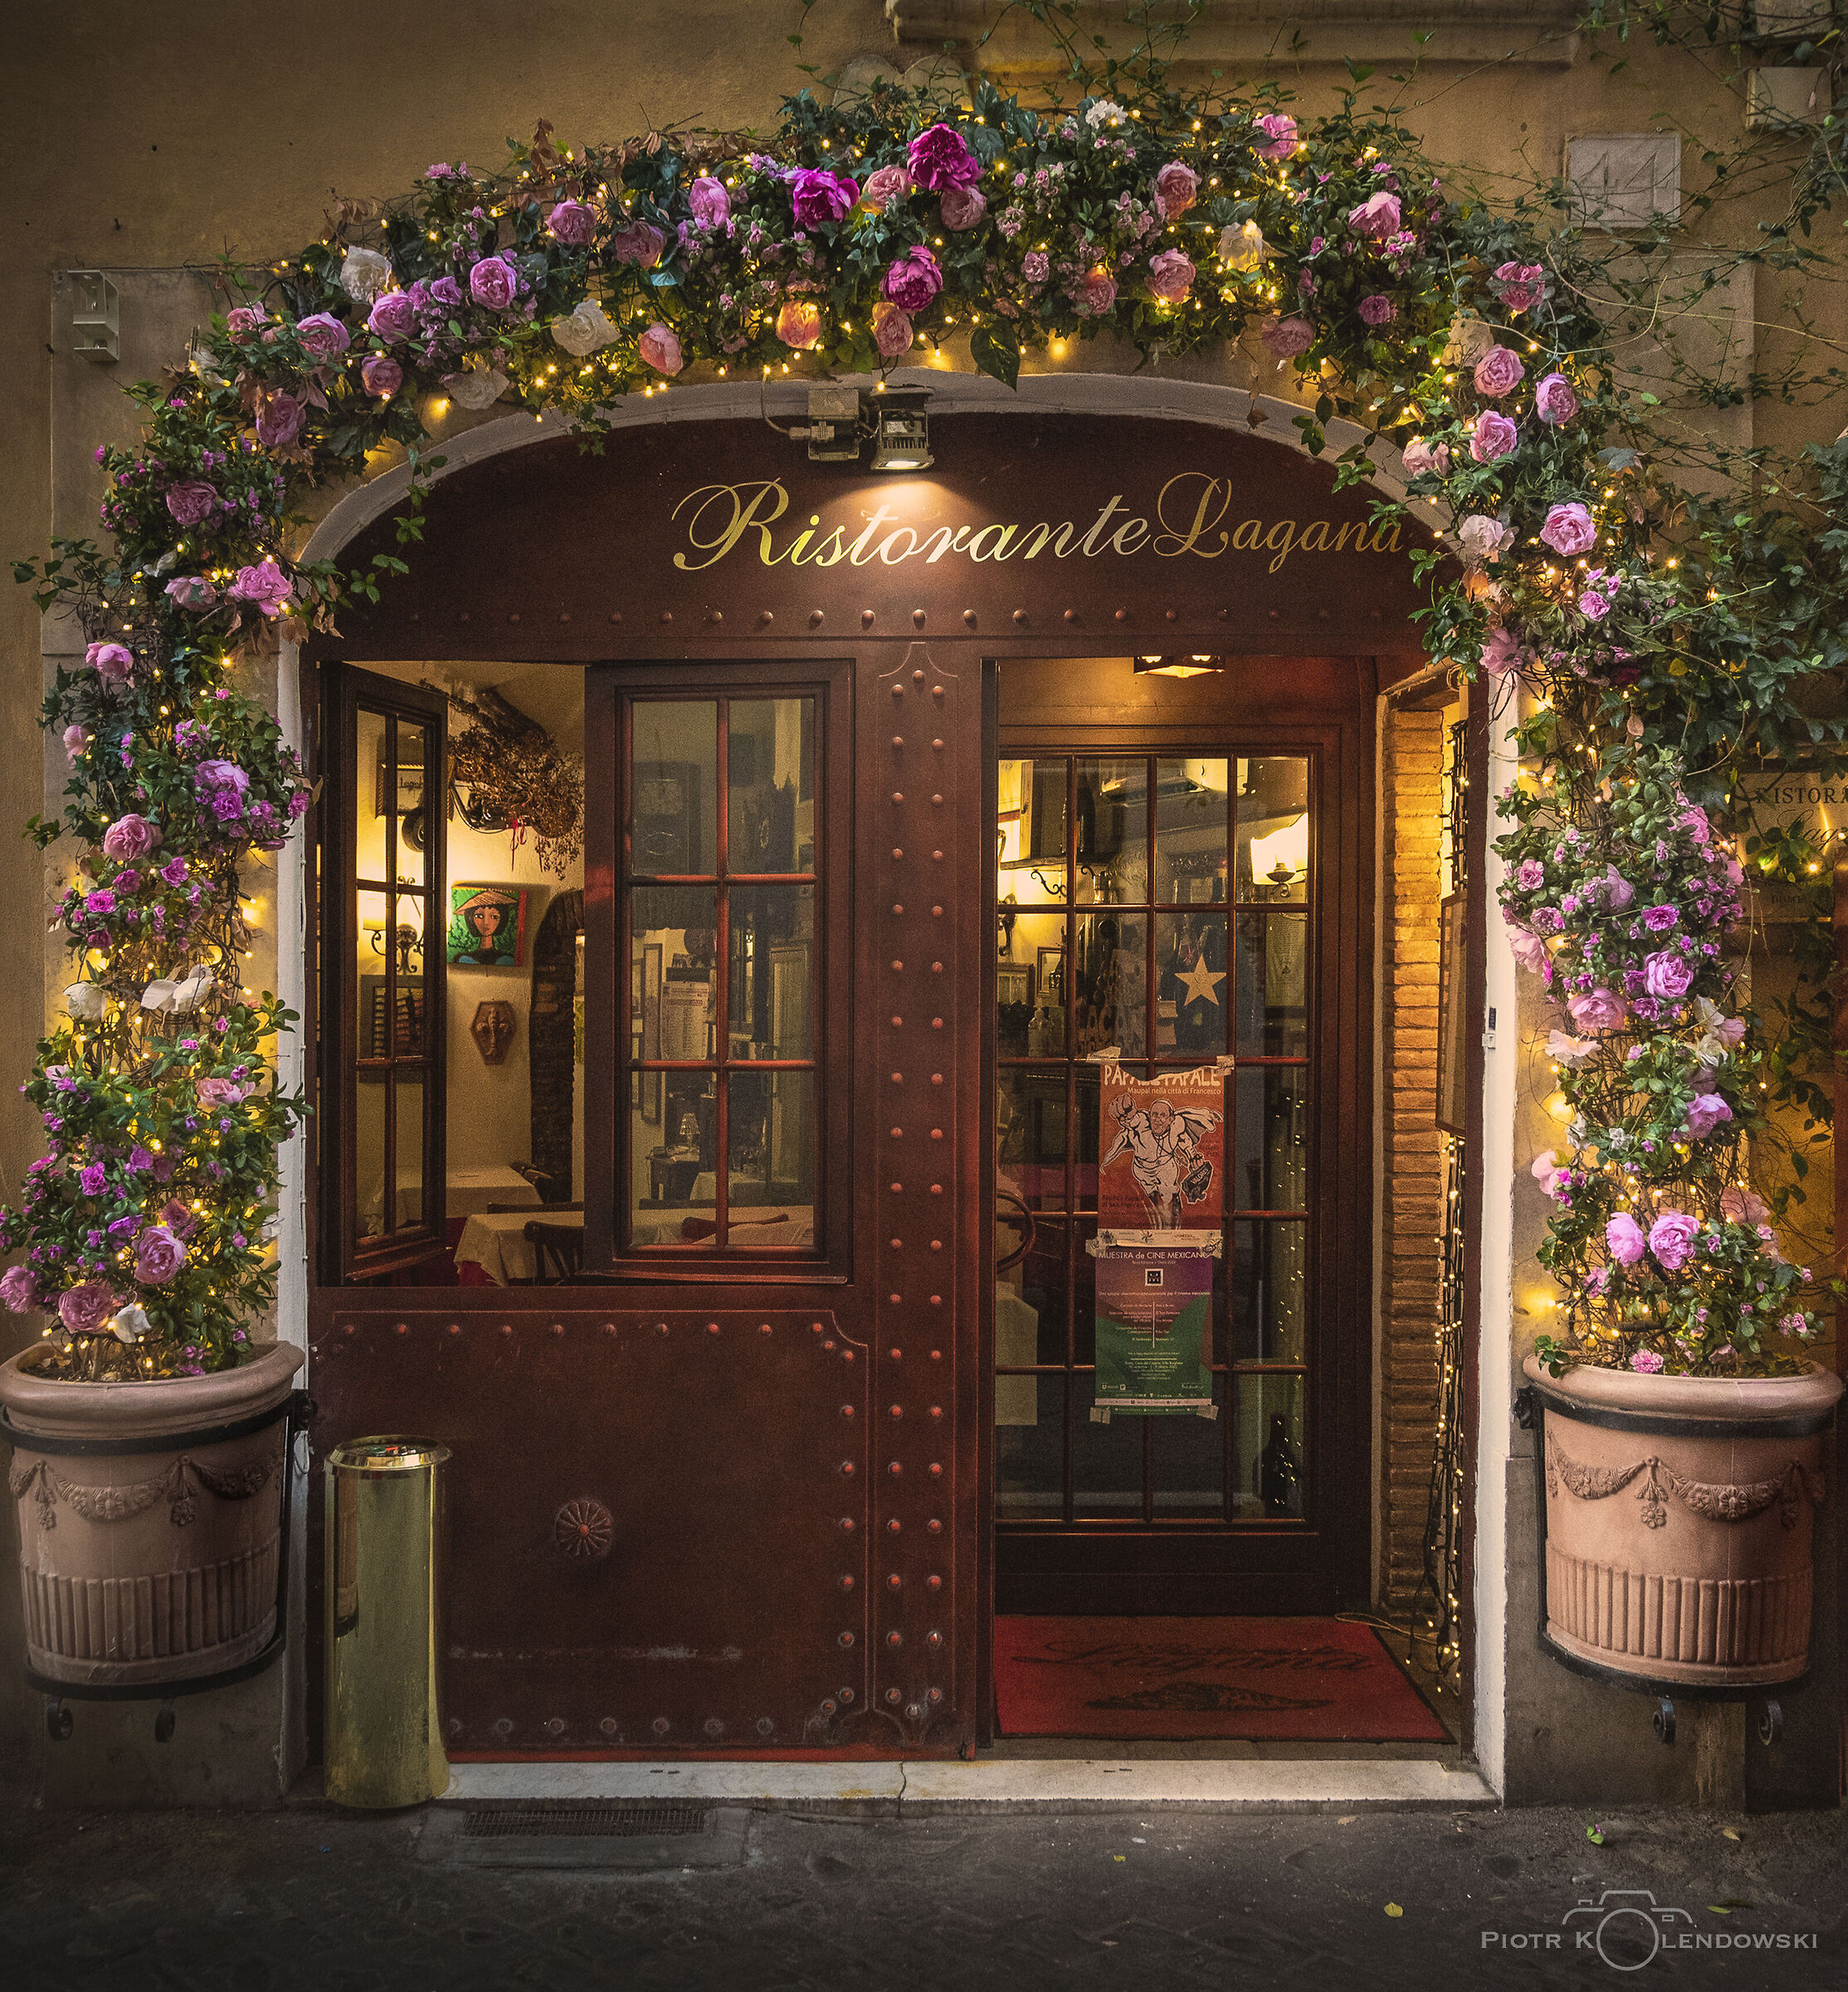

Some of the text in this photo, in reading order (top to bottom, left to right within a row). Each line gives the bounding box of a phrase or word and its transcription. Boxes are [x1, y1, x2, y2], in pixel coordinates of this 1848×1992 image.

[671, 477, 1151, 571] Ristorante
[1104, 1064, 1160, 1086] PAP
[1135, 1251, 1145, 1259] de
